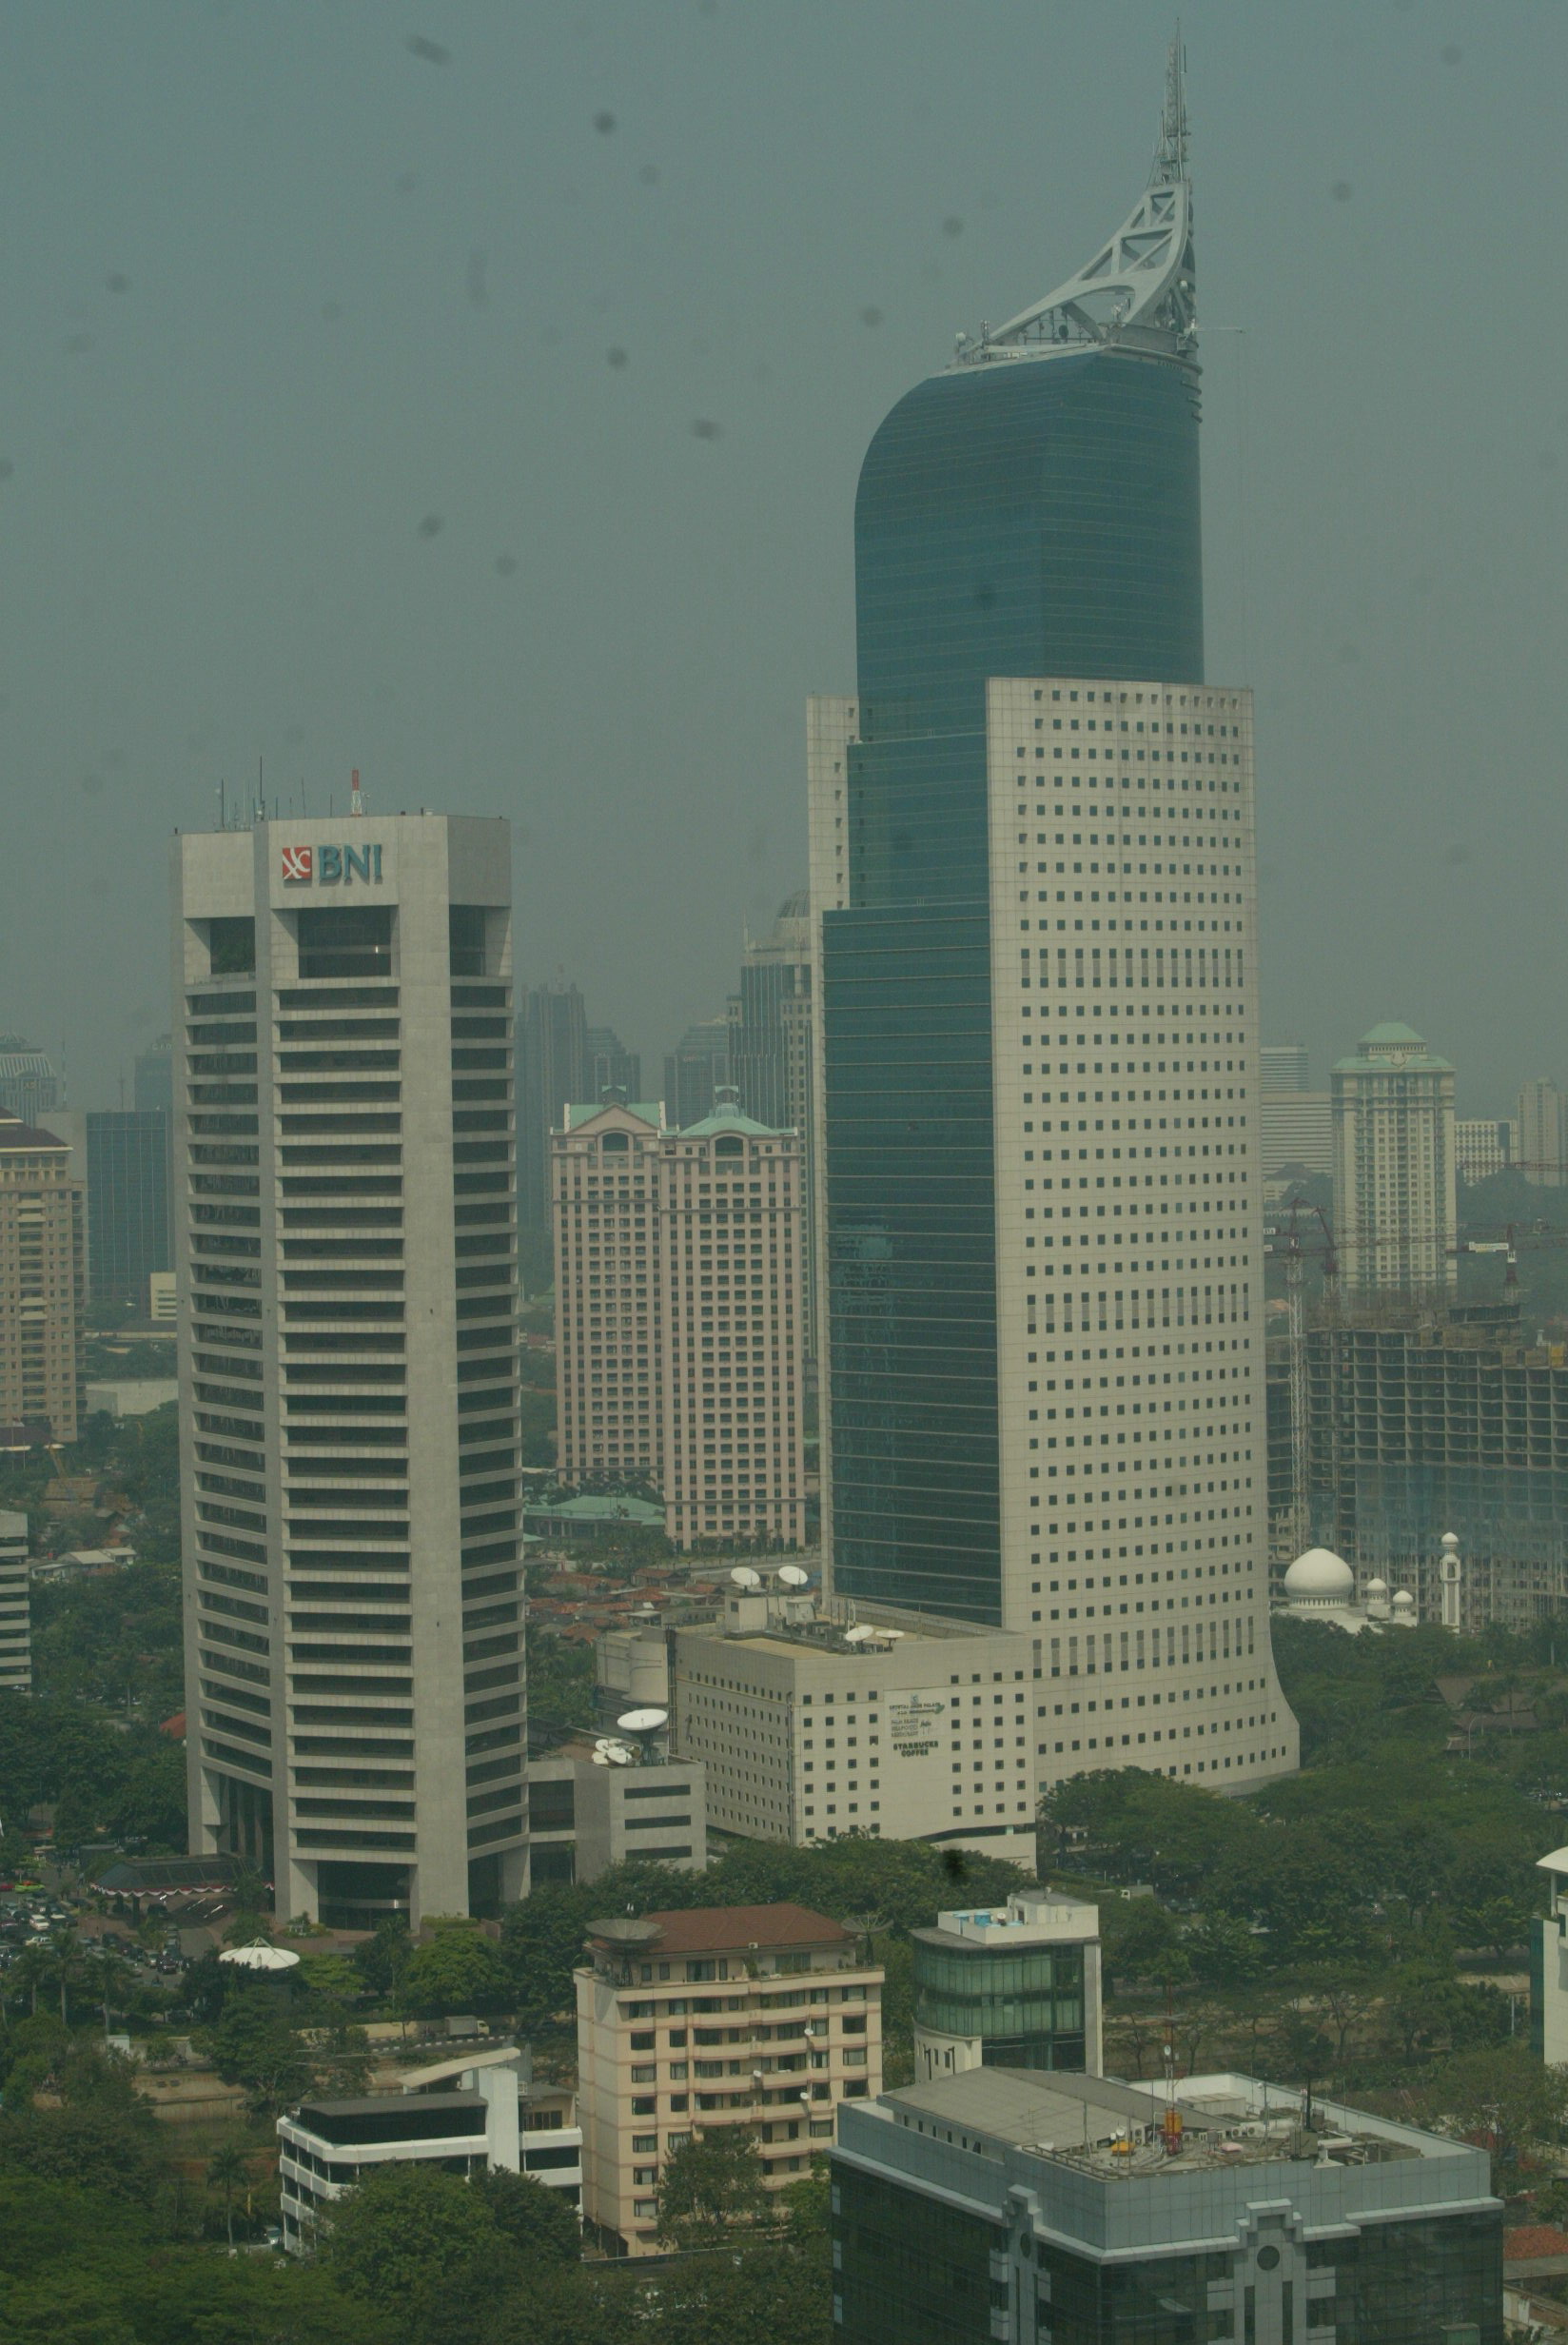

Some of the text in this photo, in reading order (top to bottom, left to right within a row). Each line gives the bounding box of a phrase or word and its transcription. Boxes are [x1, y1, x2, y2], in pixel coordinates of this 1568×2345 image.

[319, 843, 382, 881] BNI
[893, 1741, 938, 1750] STARBUCKS
[901, 1748, 929, 1757] COFFEE
